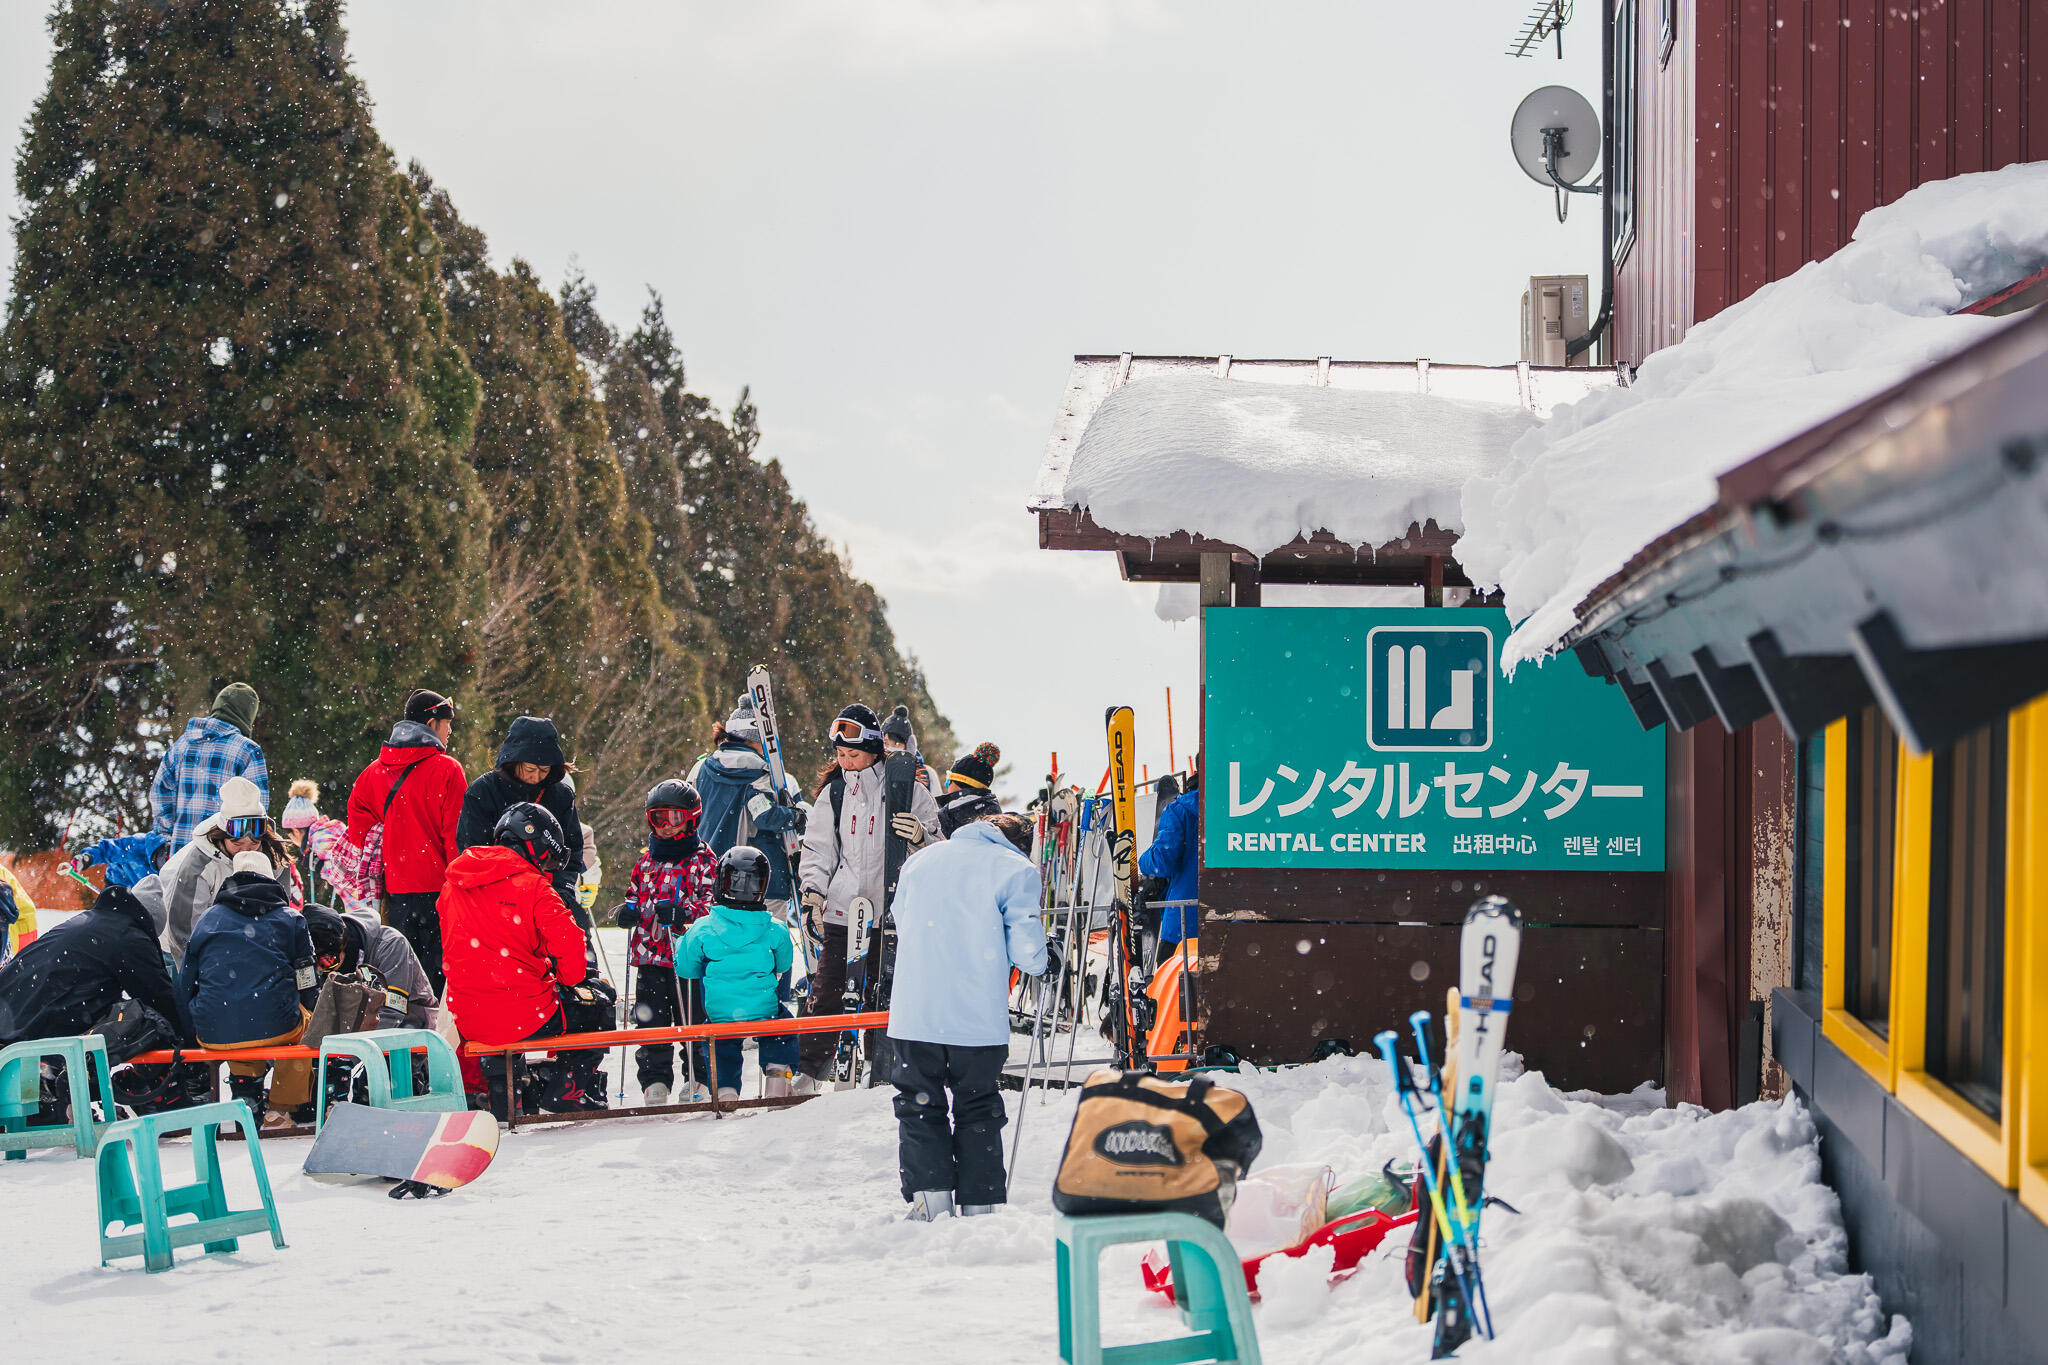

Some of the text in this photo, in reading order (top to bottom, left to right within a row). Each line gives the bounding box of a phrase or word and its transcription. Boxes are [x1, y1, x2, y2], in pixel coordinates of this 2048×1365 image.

[755, 684, 777, 754] HEAD
[1115, 731, 1126, 802] HEAD
[1228, 760, 1644, 820] レンタルセンター
[543, 829, 563, 854] SMITH
[1227, 832, 1427, 853] RENTAL CENTER
[1452, 833, 1537, 856] 出租中心
[1563, 836, 1642, 857] 렌탈 센터
[855, 909, 864, 950] HEAD
